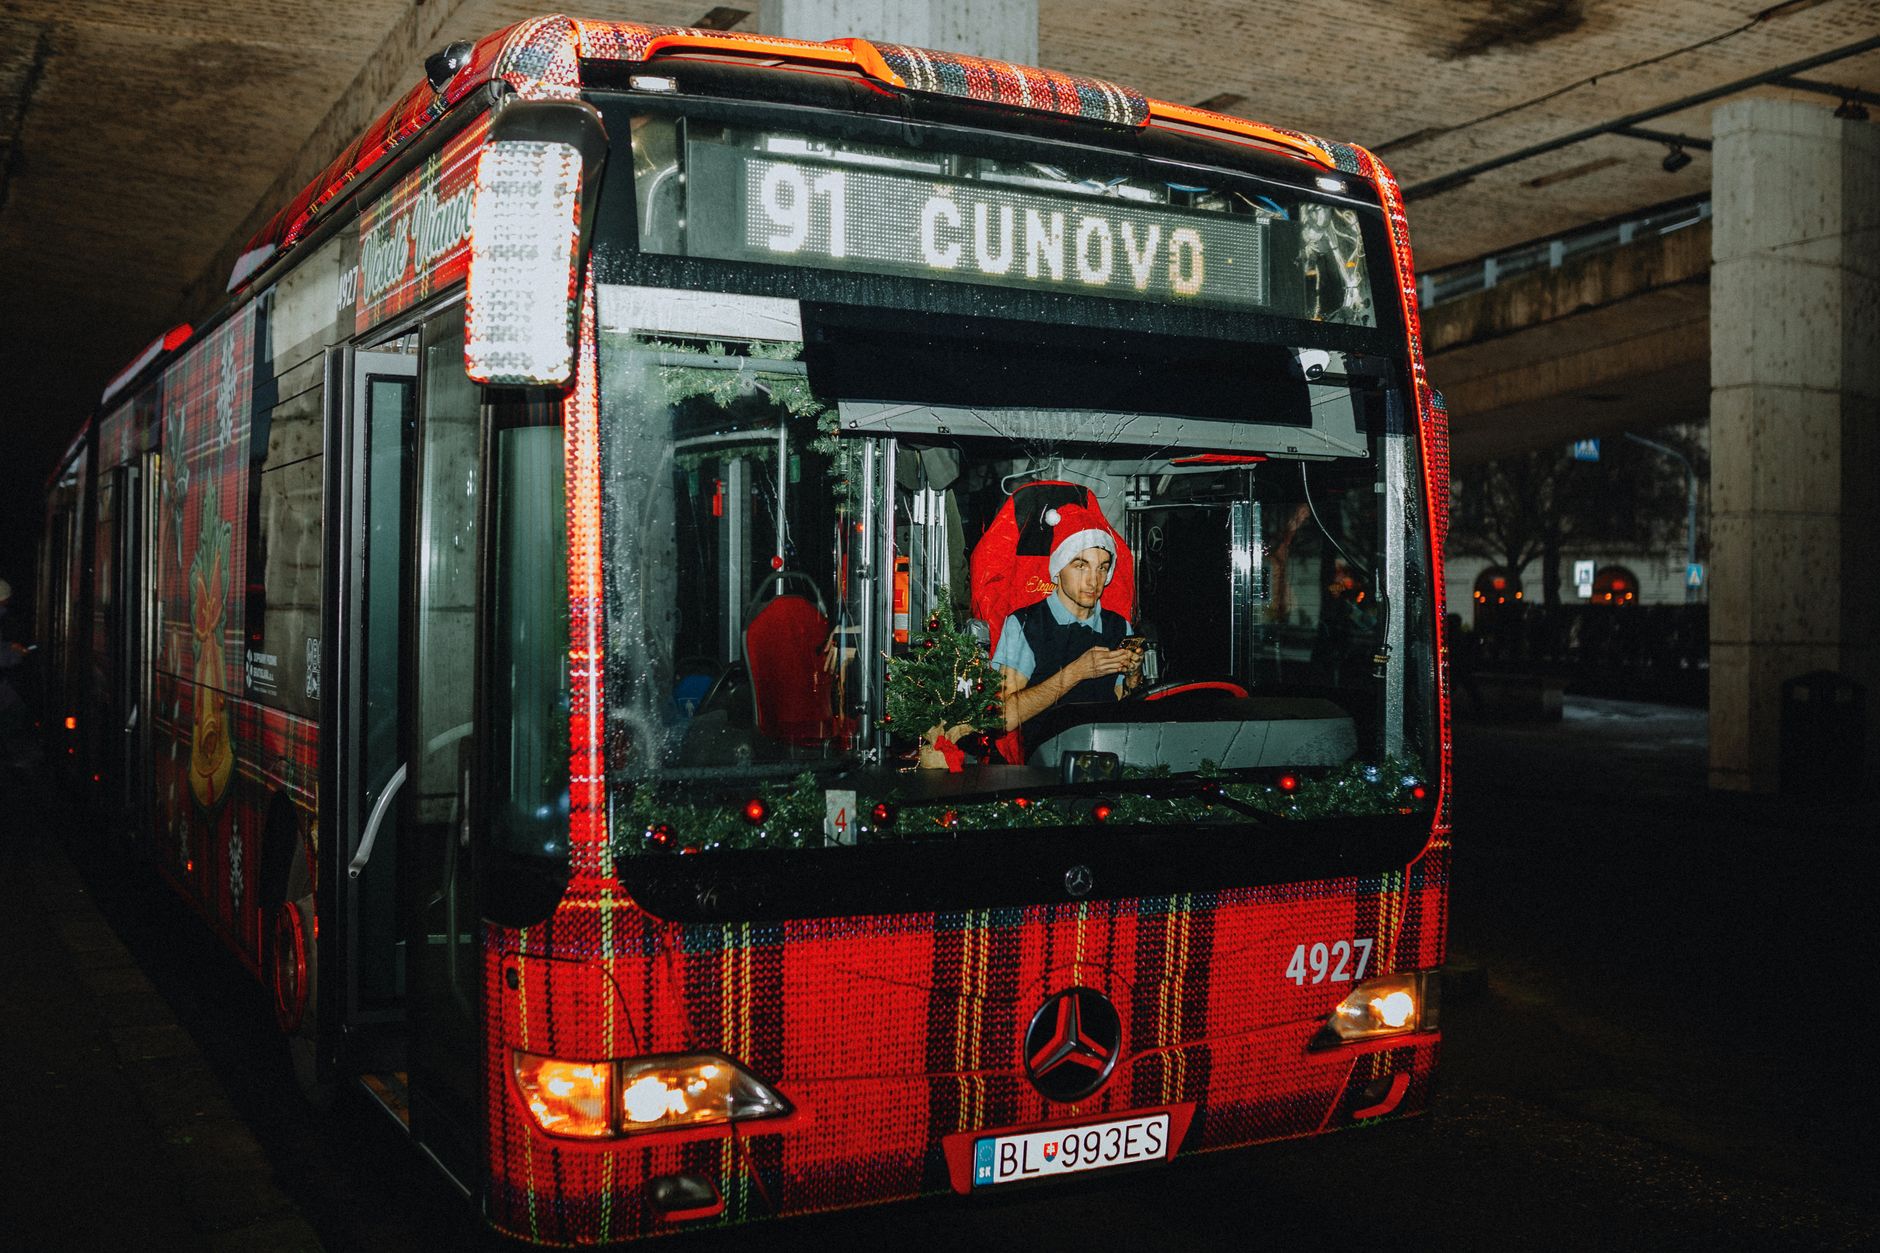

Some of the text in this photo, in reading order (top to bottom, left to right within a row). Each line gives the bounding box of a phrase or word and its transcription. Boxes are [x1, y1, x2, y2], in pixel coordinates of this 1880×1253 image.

[760, 162, 846, 258] 91
[362, 182, 475, 304] Veselé Vianoc
[338, 266, 358, 311] 4927
[834, 807, 847, 832] 4
[1285, 938, 1373, 986] 4927
[979, 1121, 1163, 1178] SK BL 993ES
